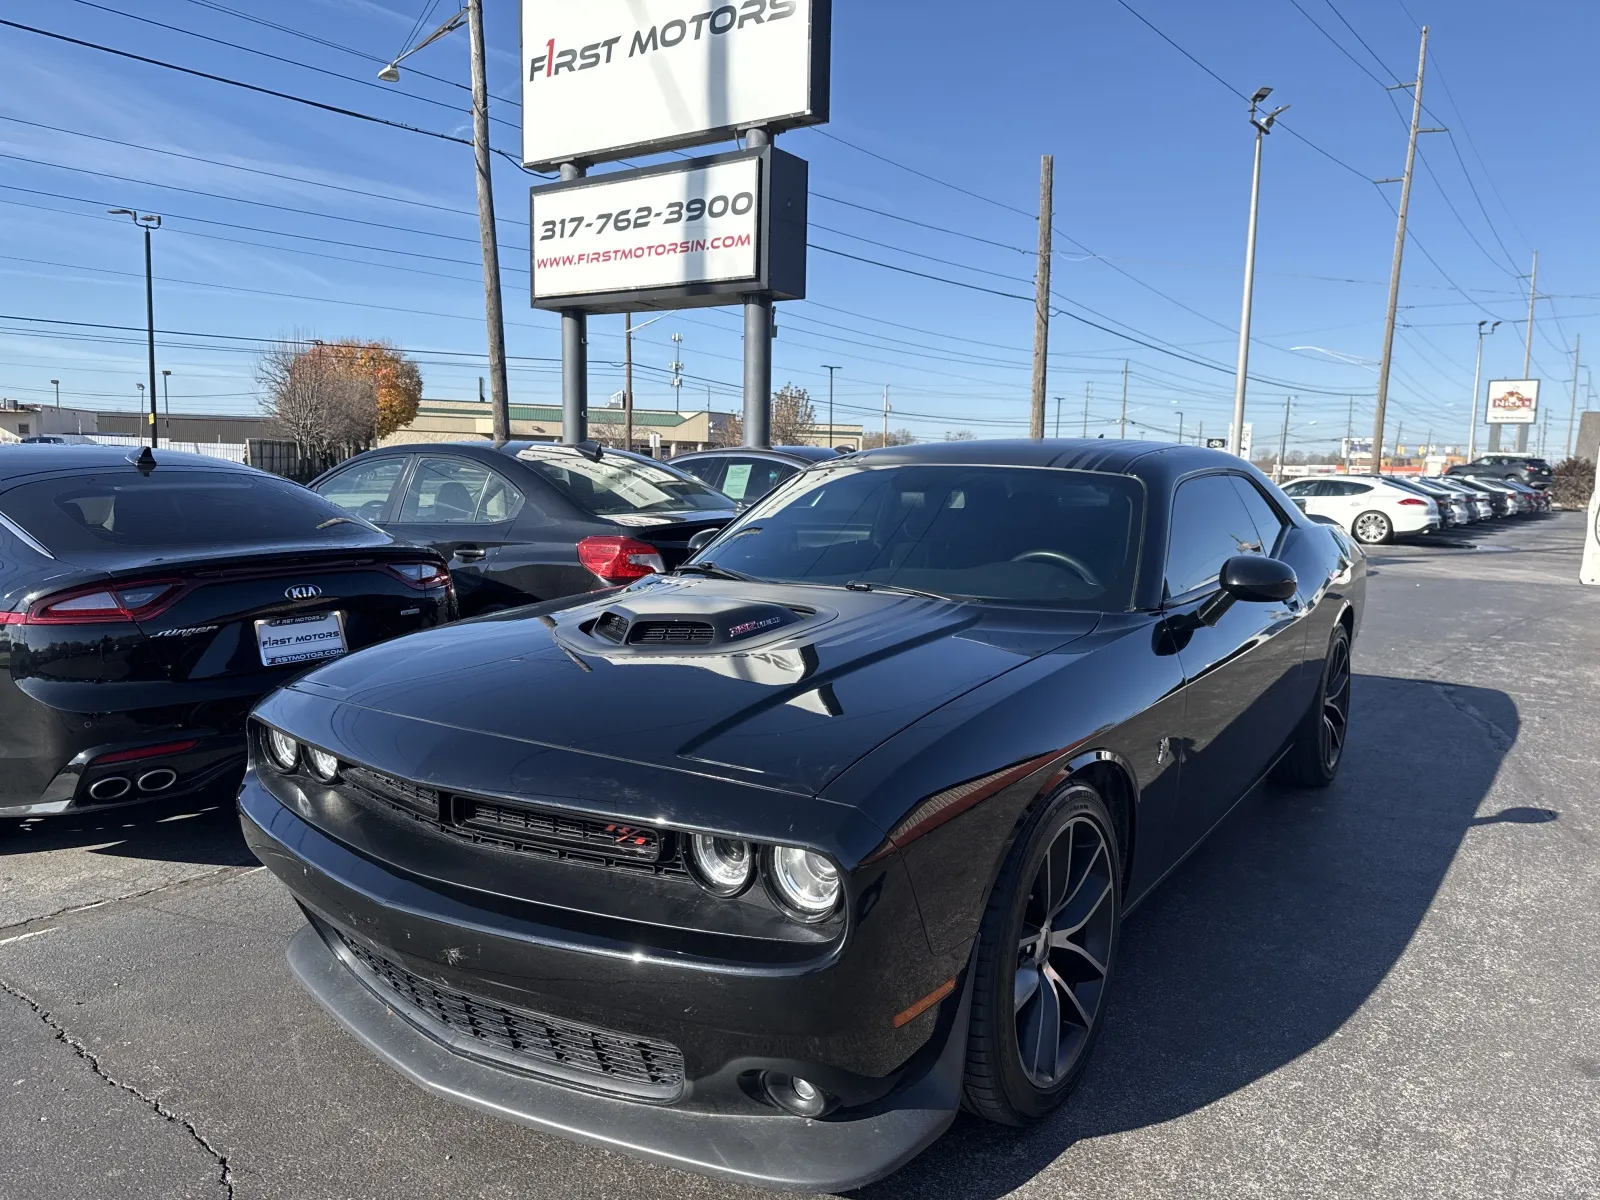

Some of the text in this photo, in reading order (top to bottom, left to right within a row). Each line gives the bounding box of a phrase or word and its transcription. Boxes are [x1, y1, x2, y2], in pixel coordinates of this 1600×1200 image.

[628, 0, 797, 58] MOTORS
[539, 191, 754, 241] 317-762-3900
[536, 233, 751, 269] WWW.FIRSTMOTORSIN.COM
[291, 586, 317, 599] KIA
[295, 630, 340, 643] MOTORS
